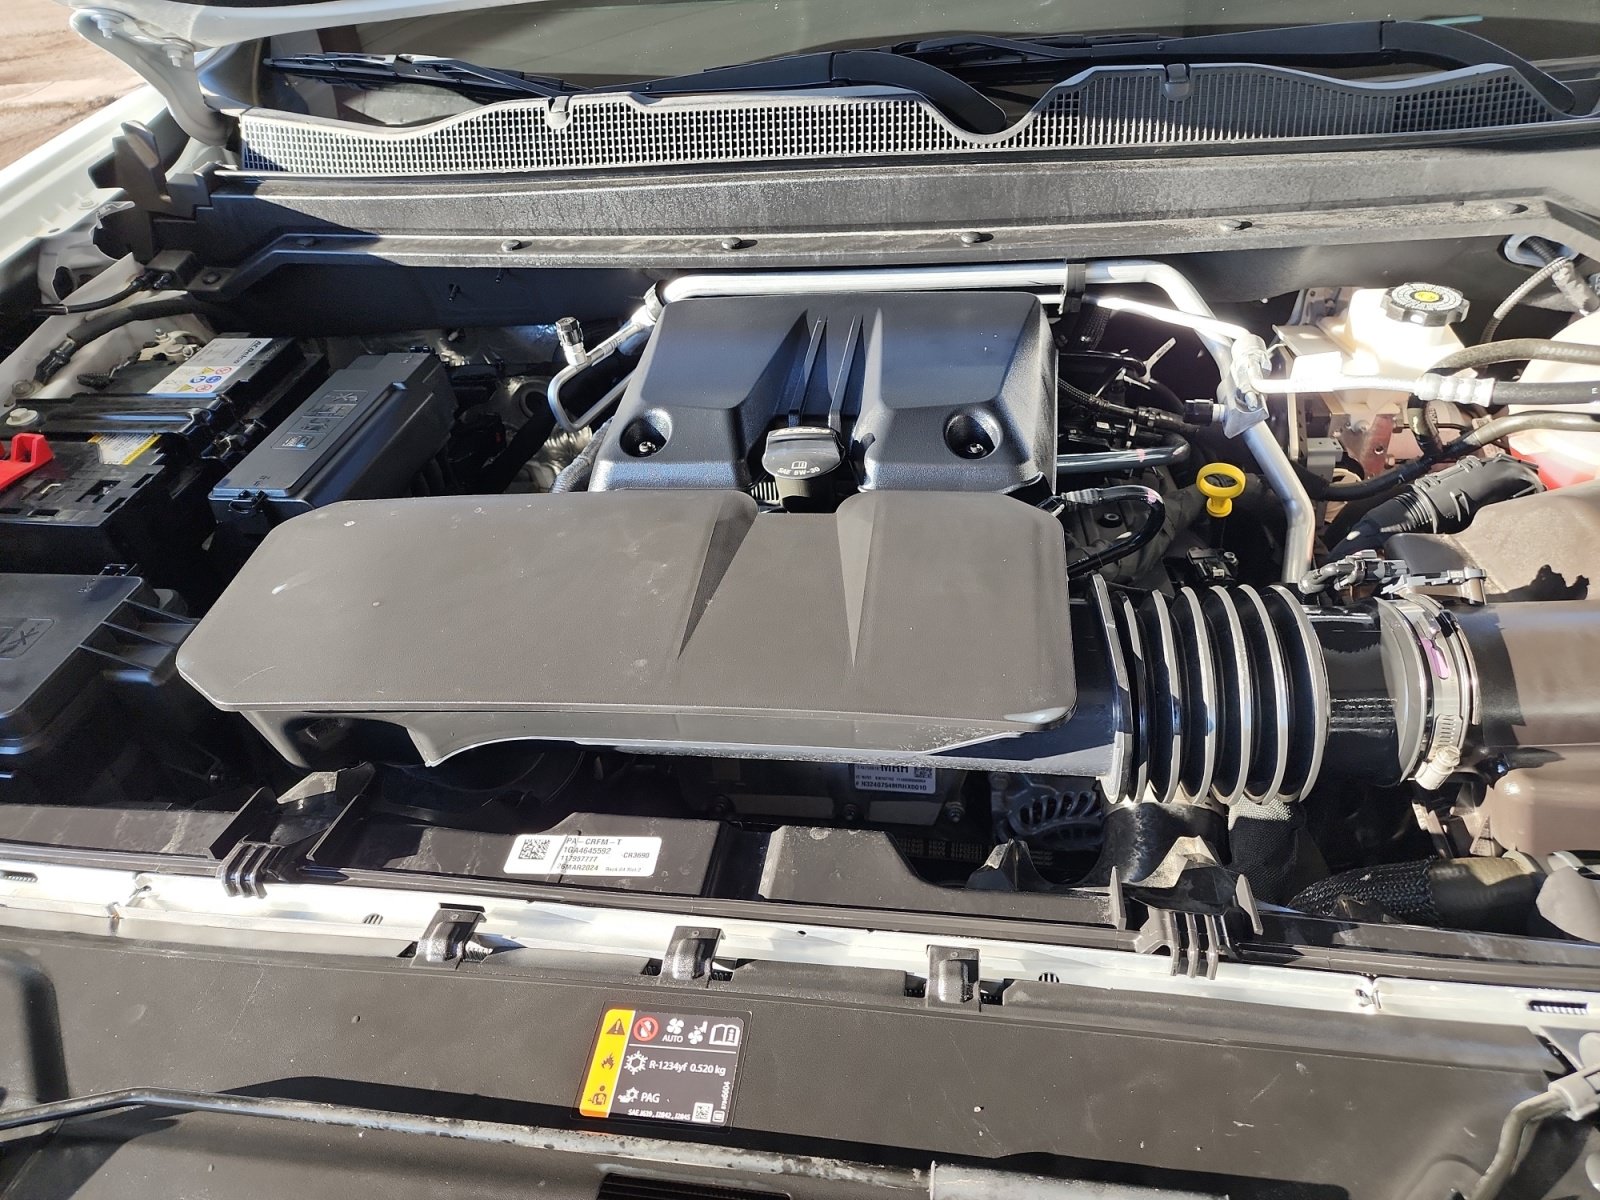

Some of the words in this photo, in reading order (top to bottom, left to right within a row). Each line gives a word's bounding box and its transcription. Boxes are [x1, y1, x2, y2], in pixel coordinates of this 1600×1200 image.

[777, 467, 792, 475] SAE
[661, 1034, 684, 1043] AUTO
[648, 1060, 688, 1074] R-1234yf
[689, 1063, 714, 1074] 0.520
[714, 1063, 727, 1077] kg
[640, 1092, 661, 1104] PAG
